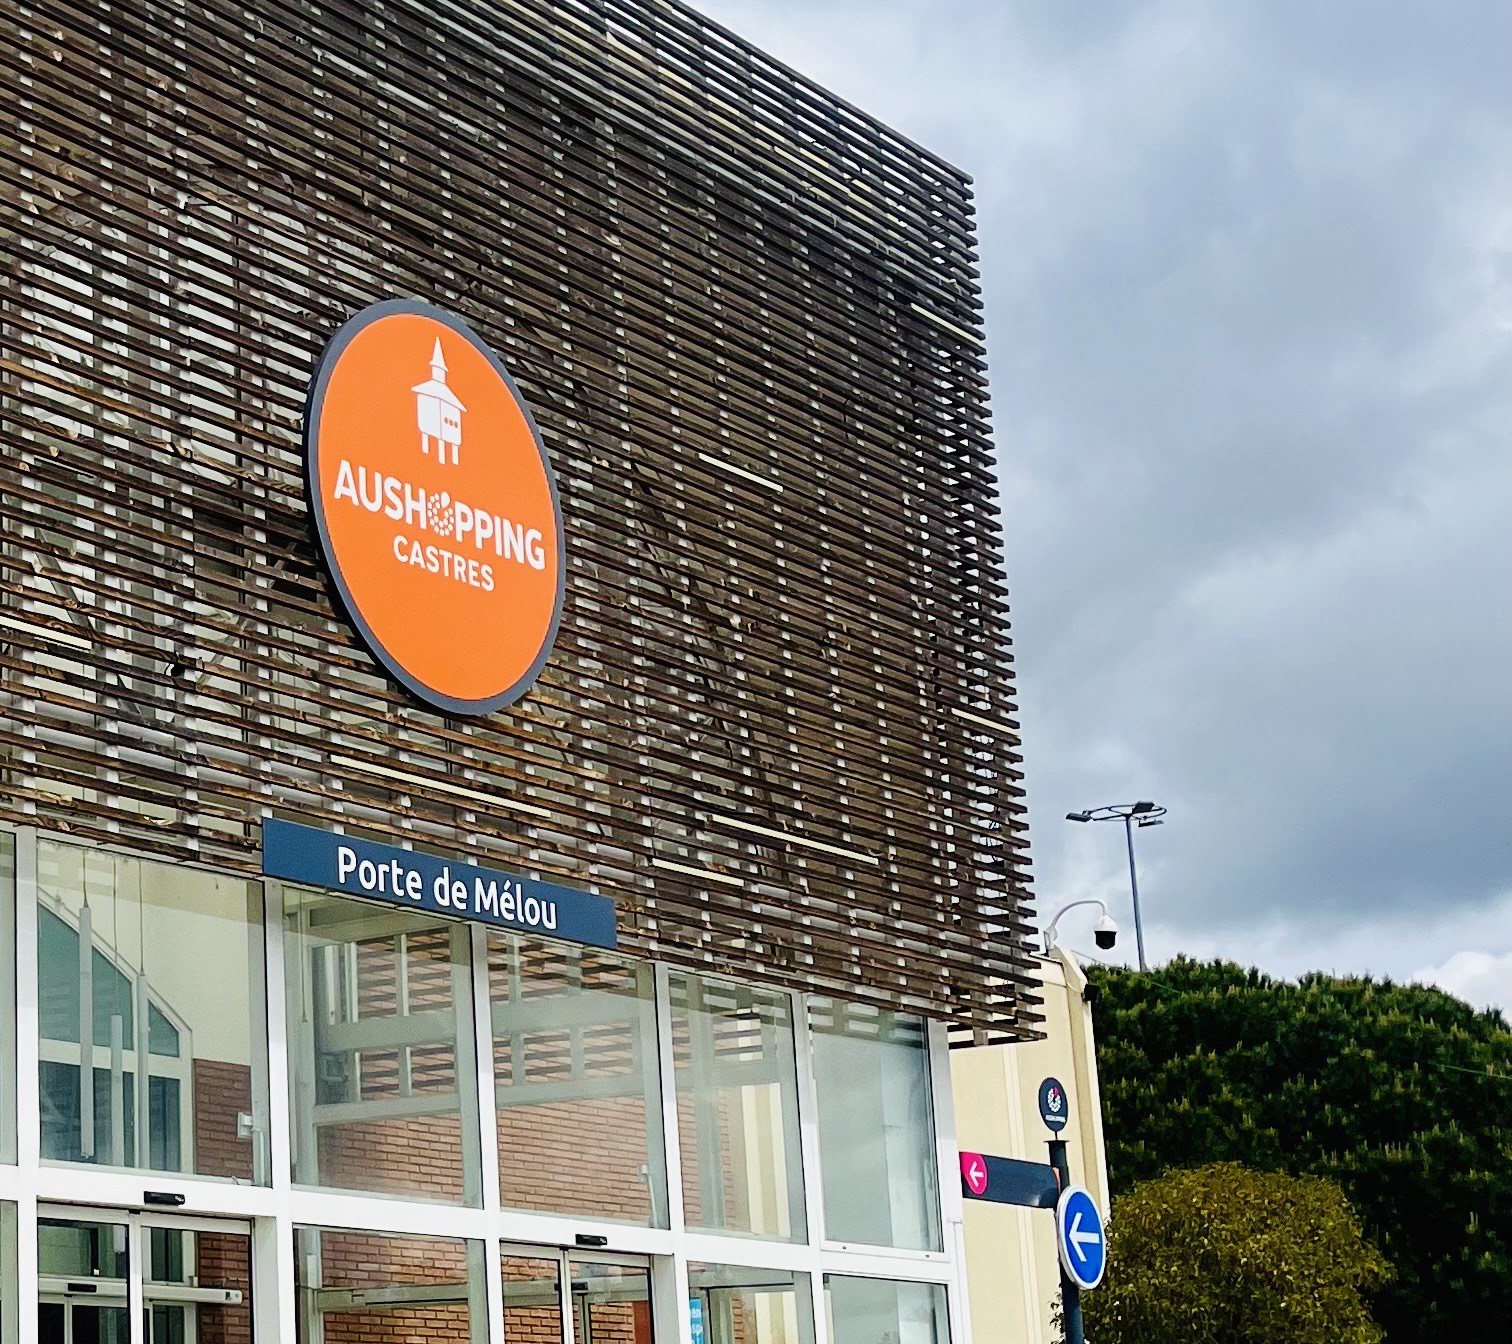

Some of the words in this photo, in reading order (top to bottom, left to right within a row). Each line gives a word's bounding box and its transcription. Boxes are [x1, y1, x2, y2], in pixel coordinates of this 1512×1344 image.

[333, 459, 546, 571] AUSHOPPING
[392, 535, 495, 592] CASTRES
[338, 846, 423, 900] Porte
[433, 866, 468, 910] de
[474, 877, 557, 930] Mélou
